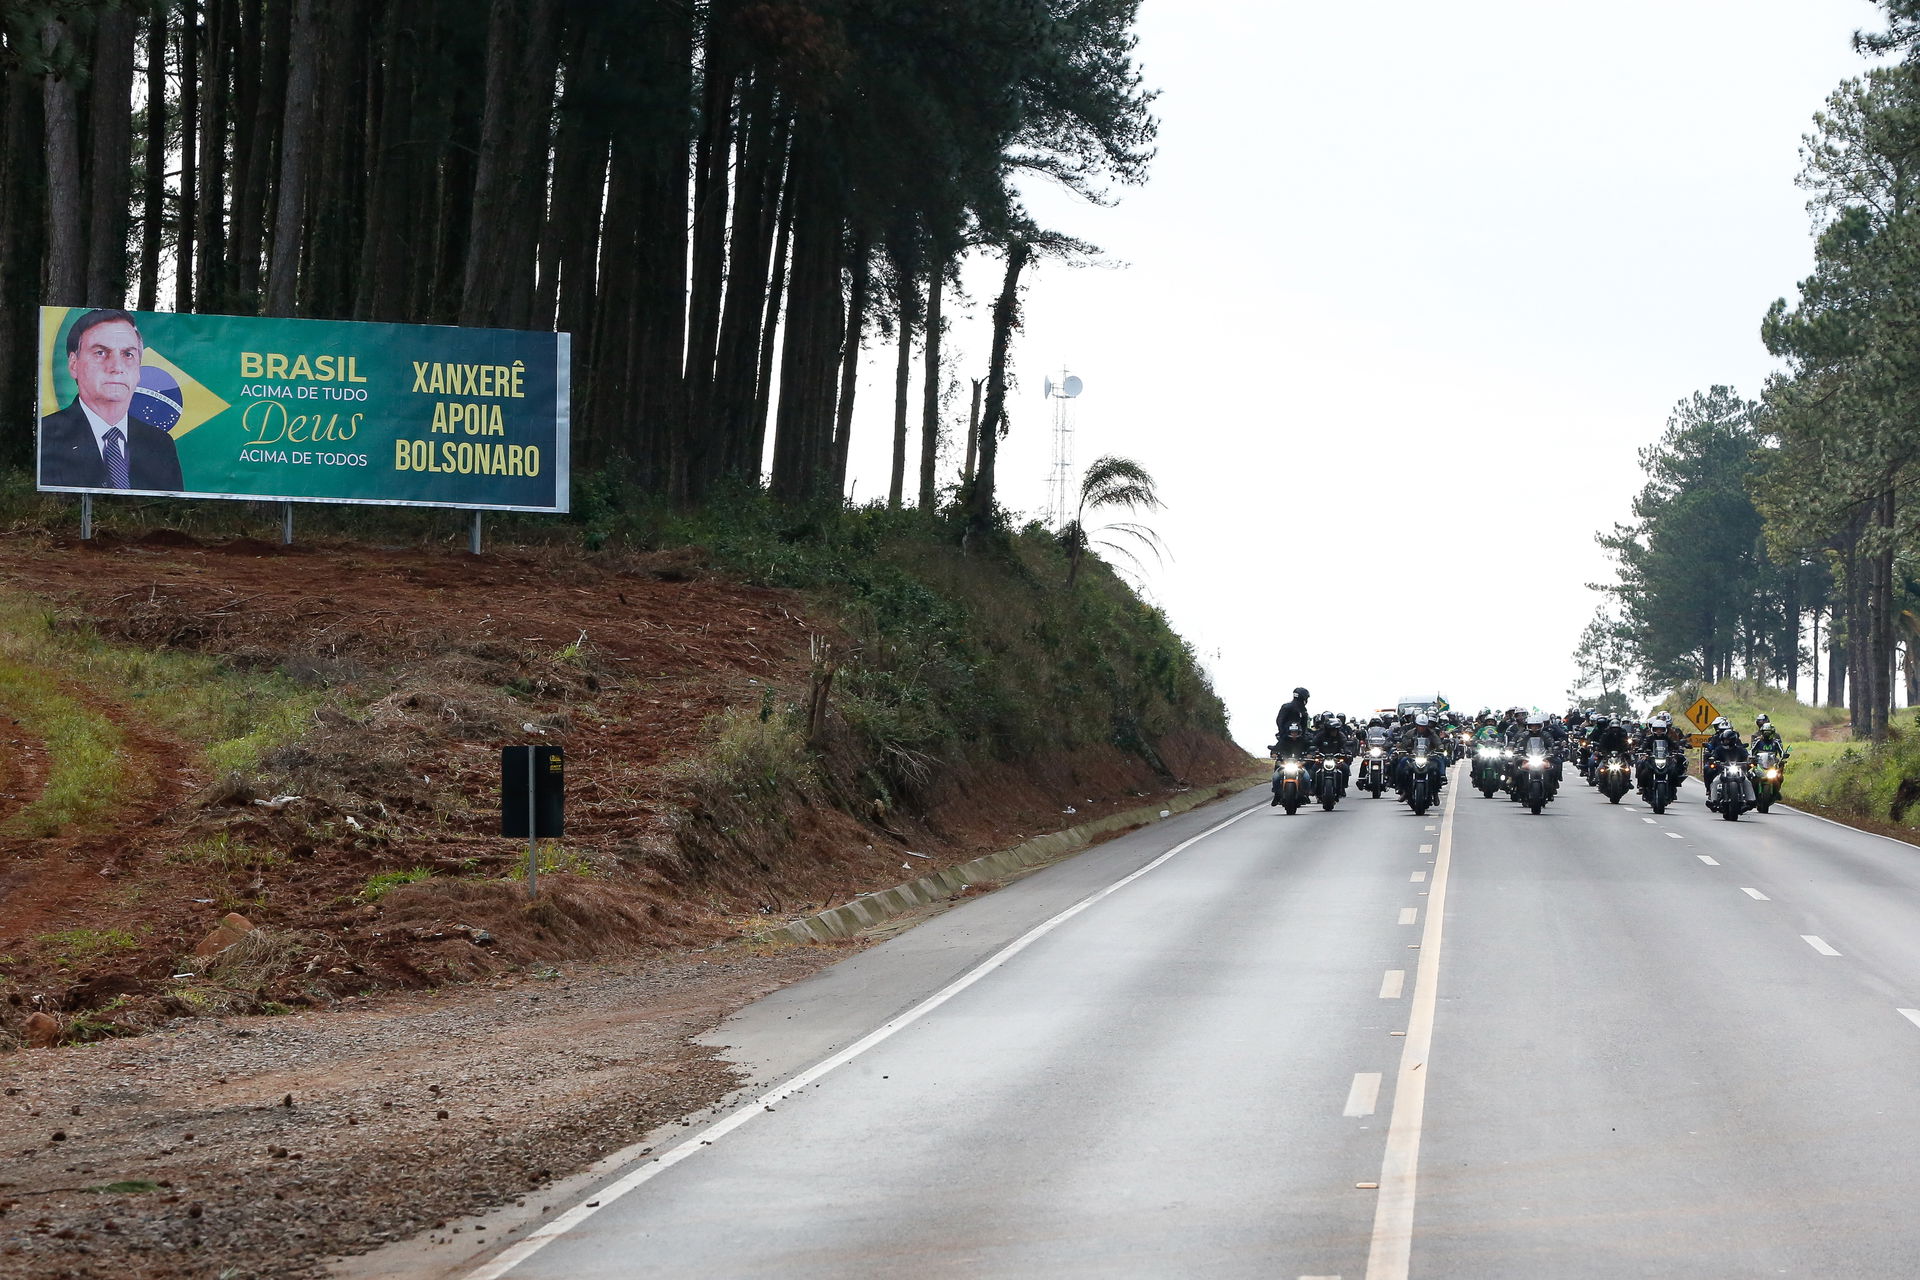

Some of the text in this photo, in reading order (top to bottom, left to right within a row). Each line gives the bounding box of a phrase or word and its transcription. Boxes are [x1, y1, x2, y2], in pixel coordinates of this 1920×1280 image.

[241, 352, 367, 382] BRASIL
[412, 360, 525, 398] XANXERÊ
[240, 384, 368, 401] ACIMA DE TUDO
[242, 400, 364, 446] Deus
[431, 402, 504, 436] APOIA
[239, 449, 368, 466] ACIMA DE TODOS
[395, 439, 540, 477] BOLSONARO
